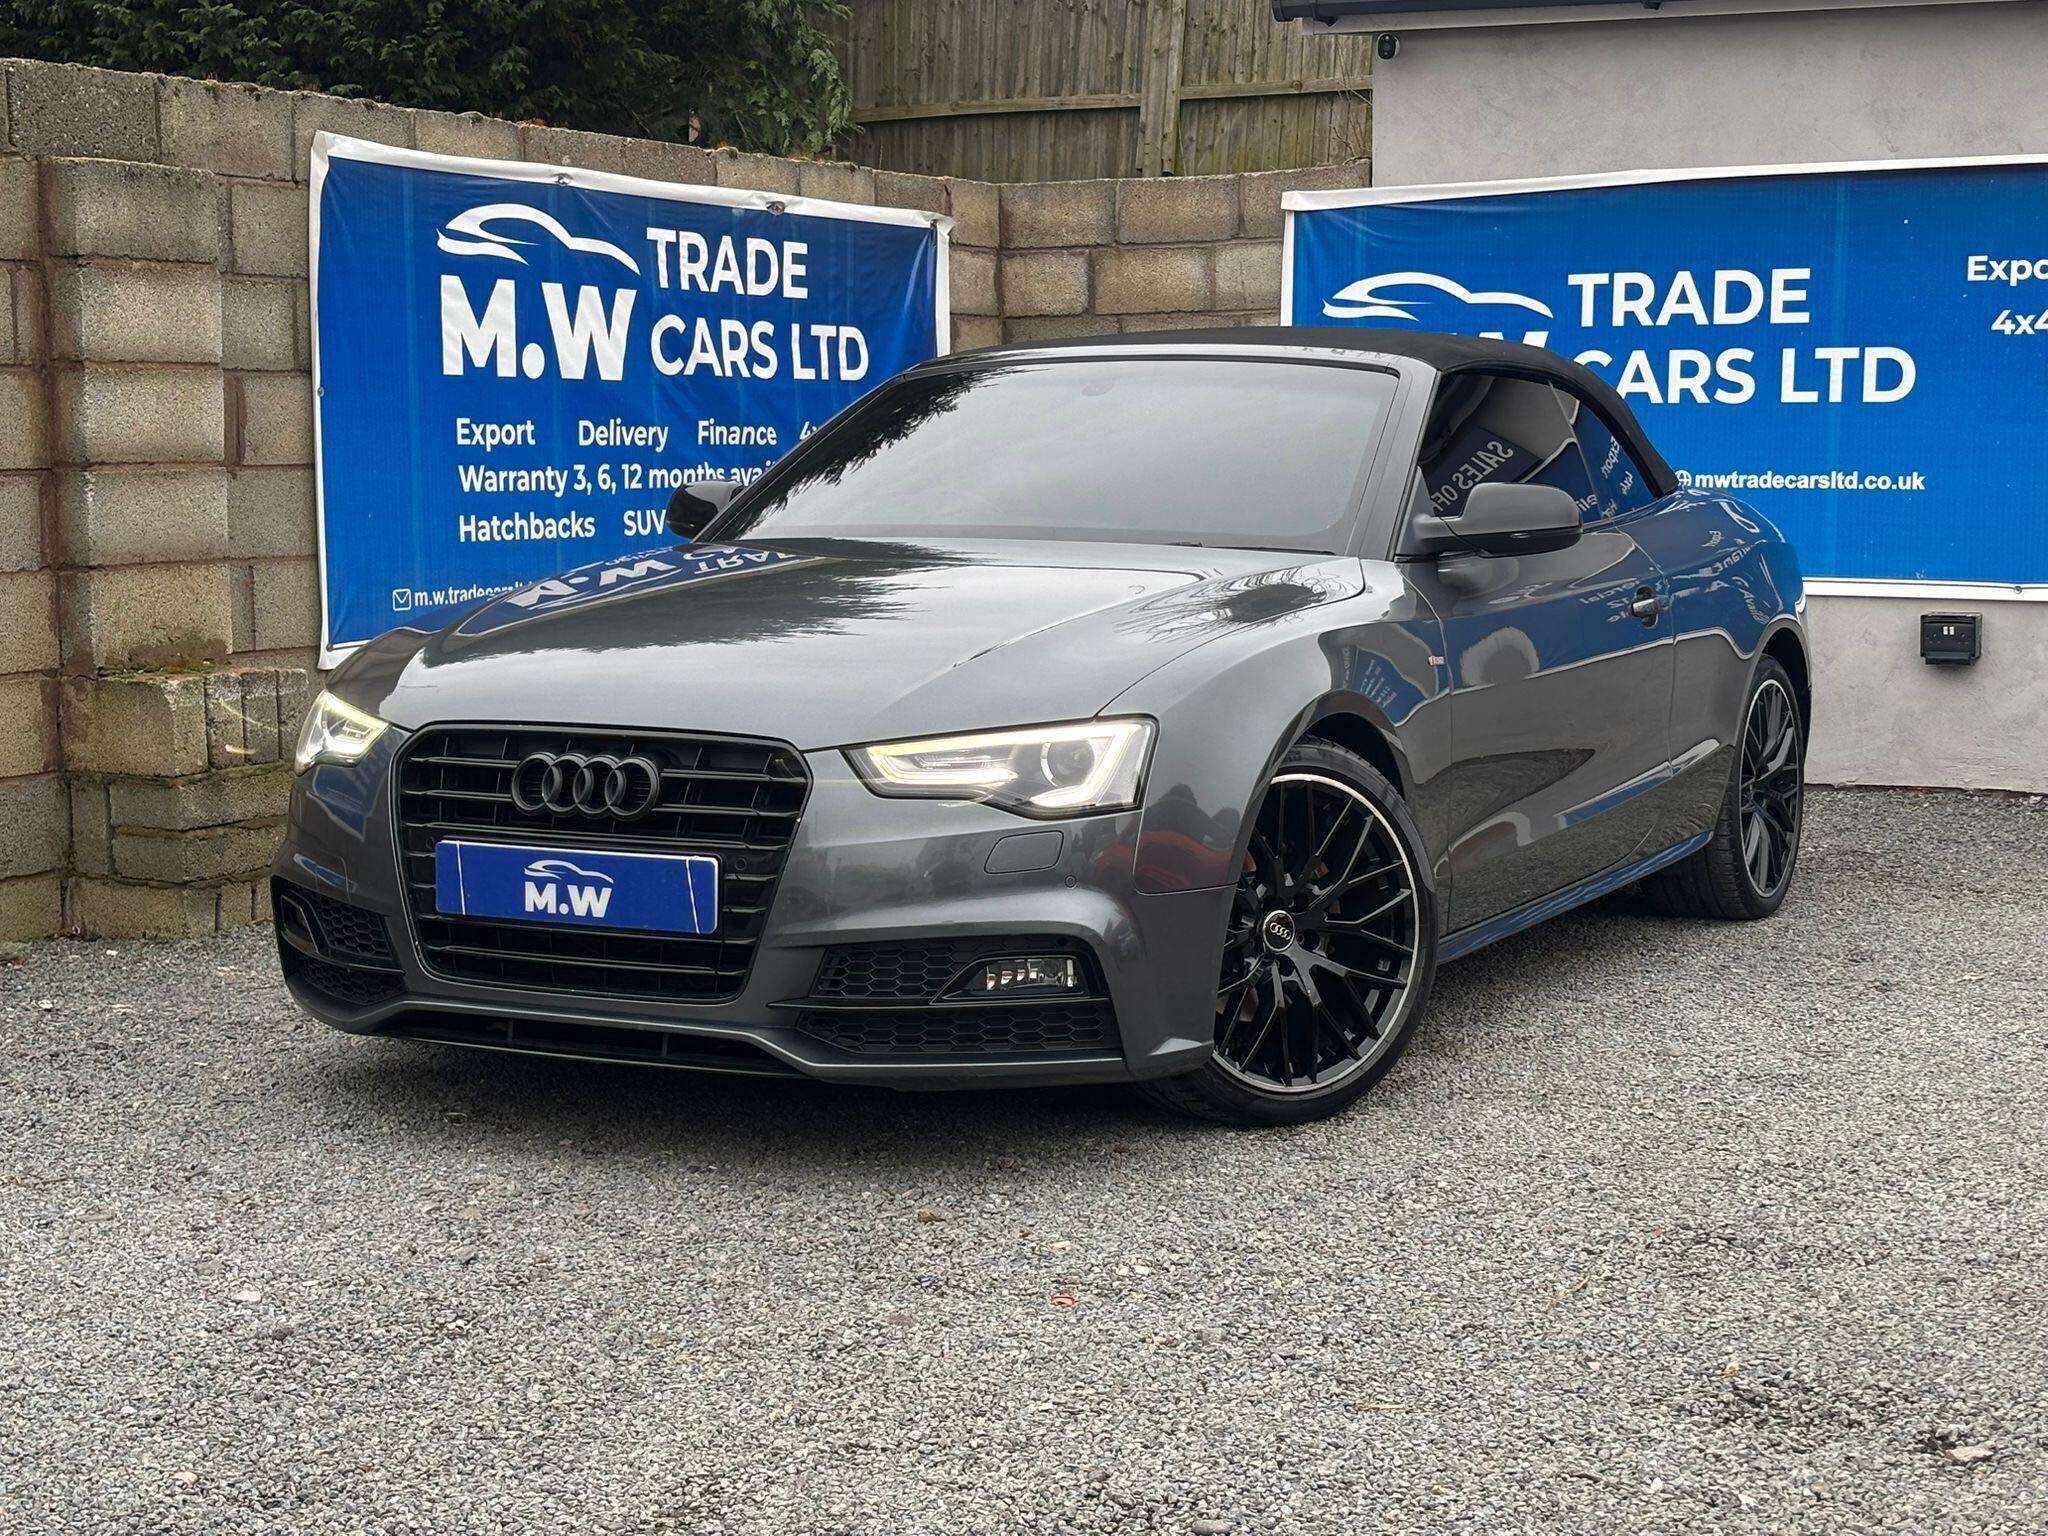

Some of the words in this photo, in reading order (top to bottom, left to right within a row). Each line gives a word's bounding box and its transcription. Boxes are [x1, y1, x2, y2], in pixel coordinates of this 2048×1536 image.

[647, 228, 808, 299] TRADE
[1568, 268, 1811, 327] TRADE
[441, 274, 640, 381] M.W
[650, 314, 778, 379] CARS
[791, 324, 869, 381] LTD
[1573, 347, 1756, 404] ARS
[1781, 346, 1917, 403] LTD
[456, 417, 536, 452] Export
[578, 417, 669, 452] Delivery
[698, 418, 777, 446] Finance
[458, 464, 568, 498] Warranty
[573, 464, 592, 496] 3,
[597, 463, 617, 495] 6,
[621, 463, 643, 489] 12
[1694, 470, 1926, 490] mwtradecarsltd.co.uk
[459, 510, 596, 543] Hatchbacks
[524, 880, 613, 918] M.W
